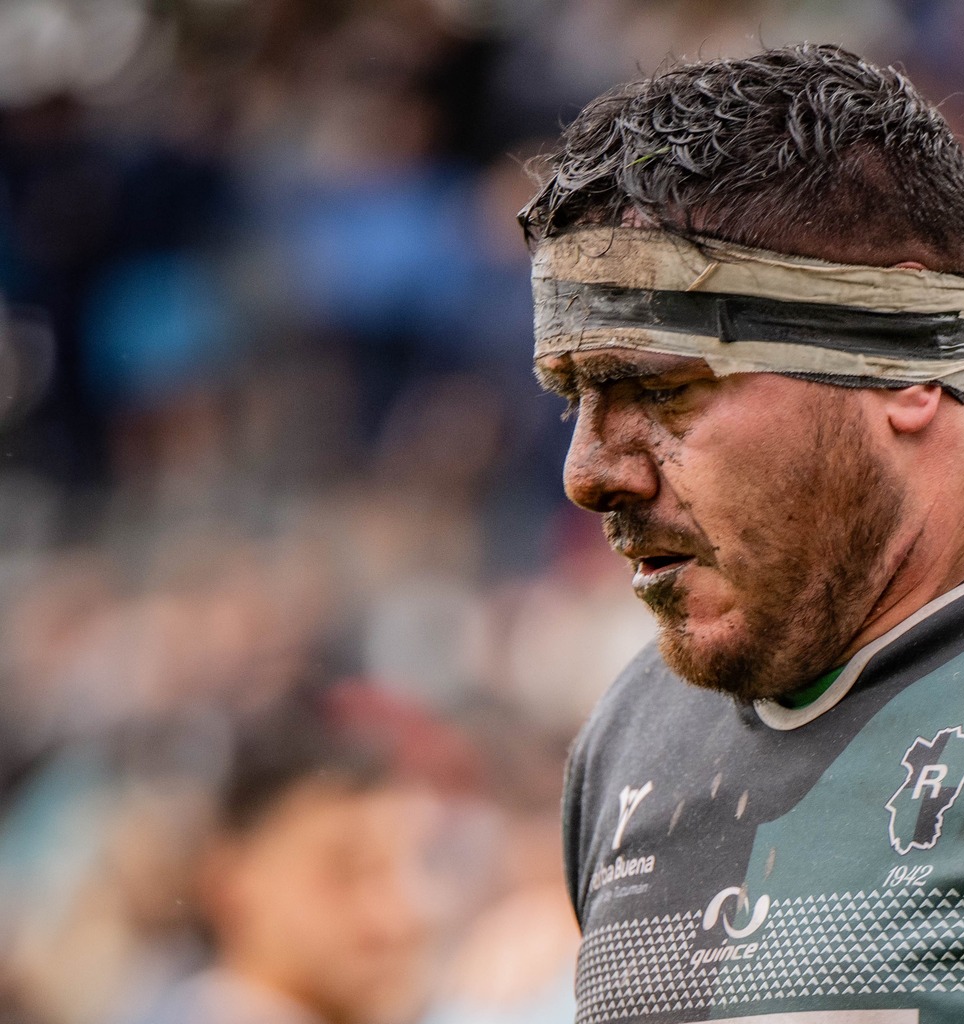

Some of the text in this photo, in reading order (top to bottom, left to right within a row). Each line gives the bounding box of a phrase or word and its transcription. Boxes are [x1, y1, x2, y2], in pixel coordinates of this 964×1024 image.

[911, 763, 948, 800] R
[881, 864, 934, 888] 1942
[689, 938, 759, 972] quince
